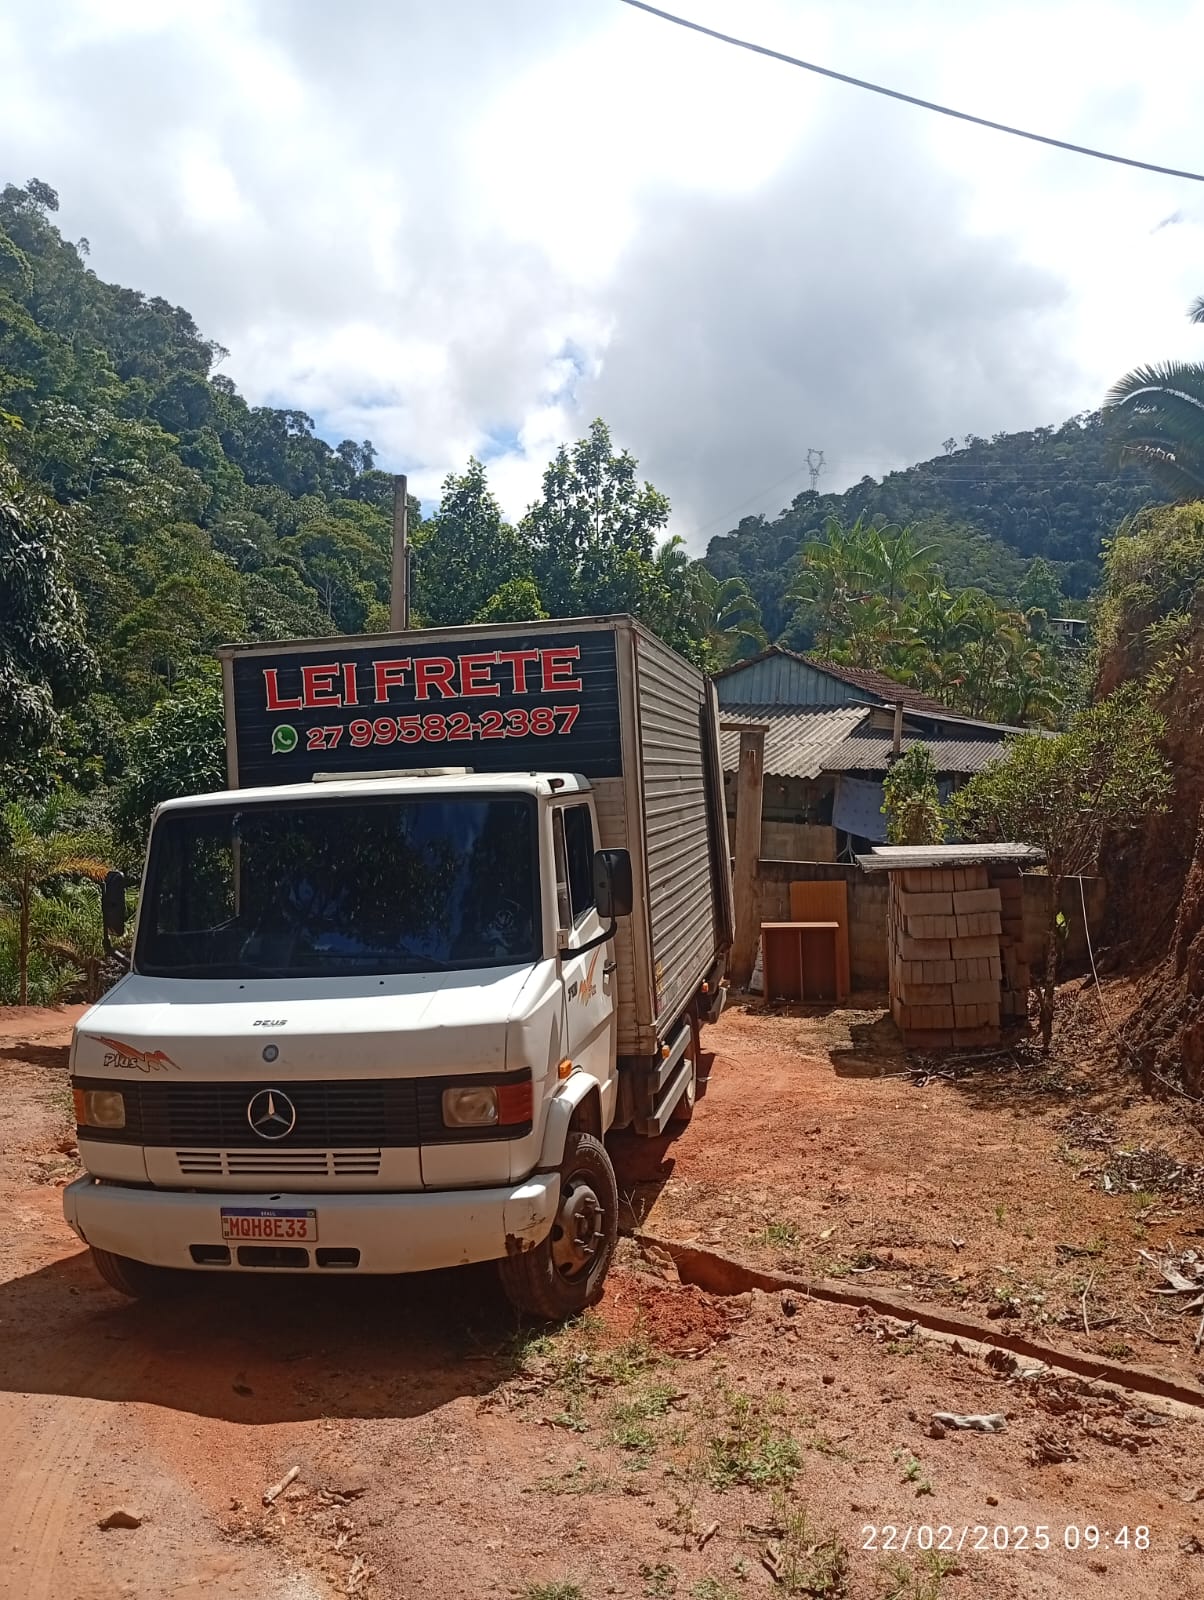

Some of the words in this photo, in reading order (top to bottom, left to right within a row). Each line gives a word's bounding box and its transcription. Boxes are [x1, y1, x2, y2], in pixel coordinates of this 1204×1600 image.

[263, 663, 358, 711] LEI
[372, 645, 583, 703] FRETE
[306, 725, 344, 752] 27
[349, 705, 580, 747] 99582-2387
[104, 1053, 139, 1068] Plus
[228, 1217, 308, 1238] MQH8E33
